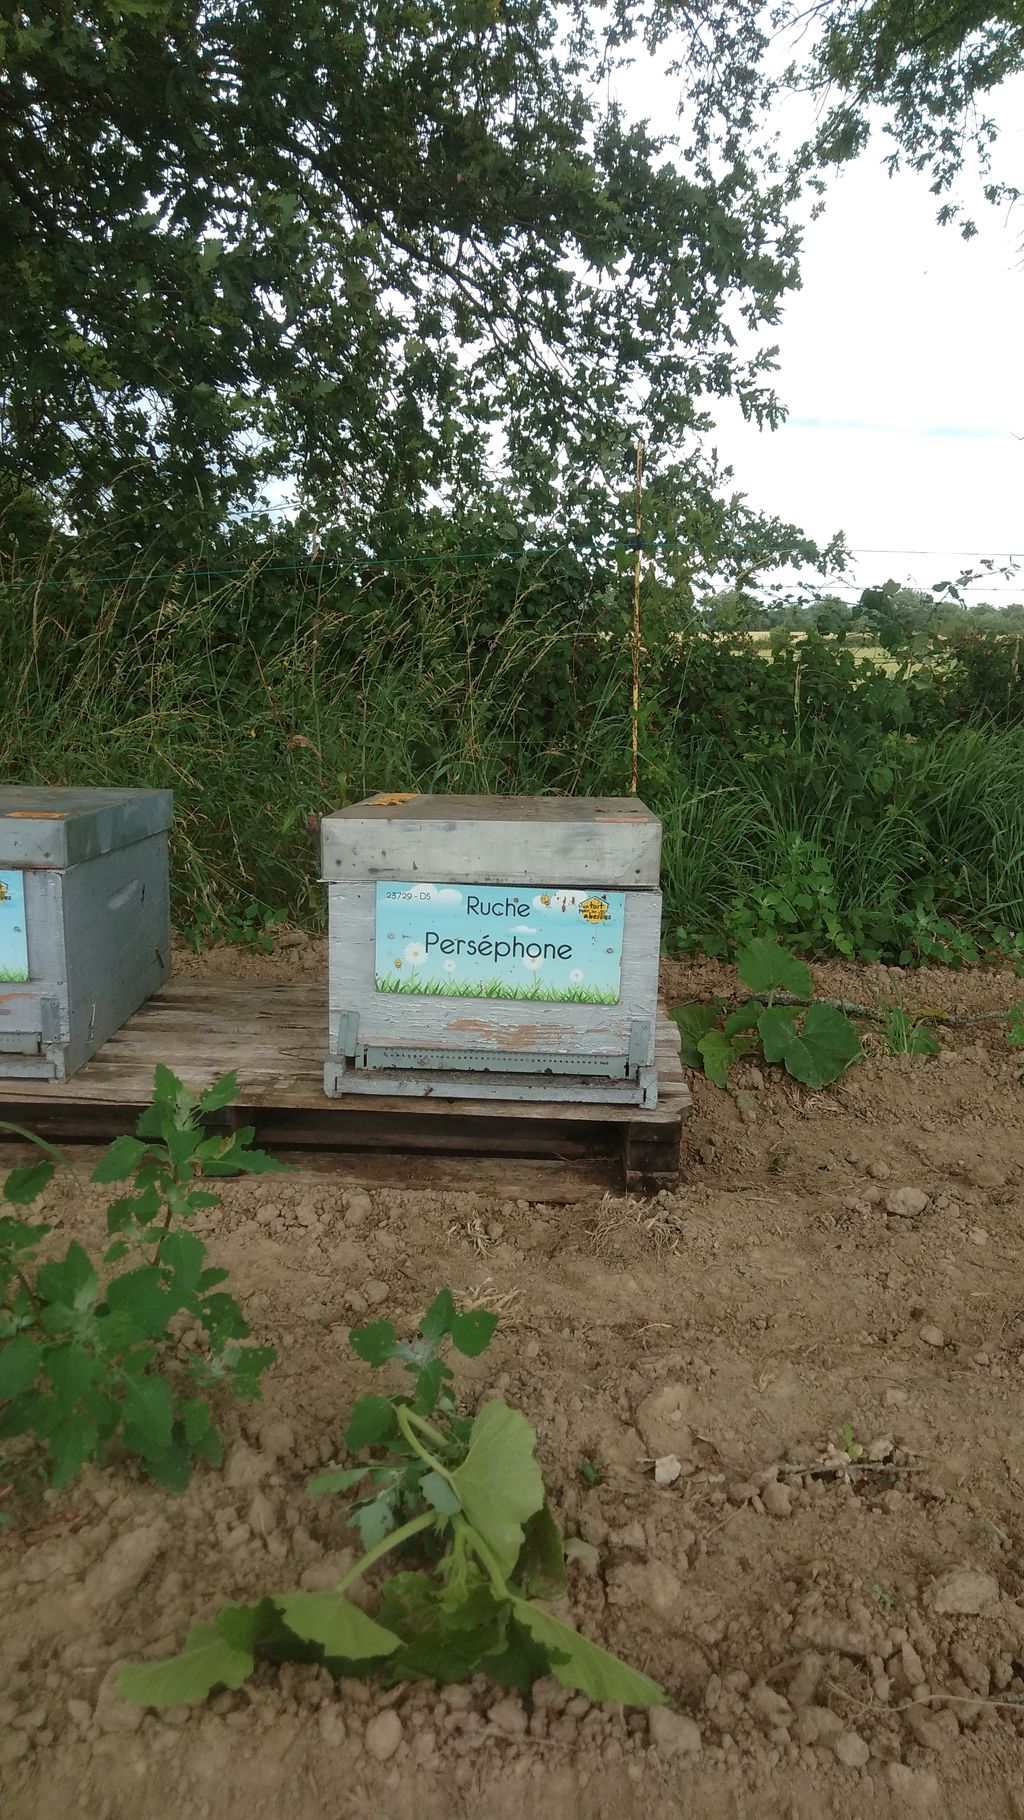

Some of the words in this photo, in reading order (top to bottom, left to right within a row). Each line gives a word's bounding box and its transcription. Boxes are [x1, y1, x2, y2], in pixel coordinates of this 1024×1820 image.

[386, 891, 413, 901] 23729
[419, 892, 432, 901] DS
[466, 895, 531, 918] Ruche
[425, 931, 573, 963] Perséphone
